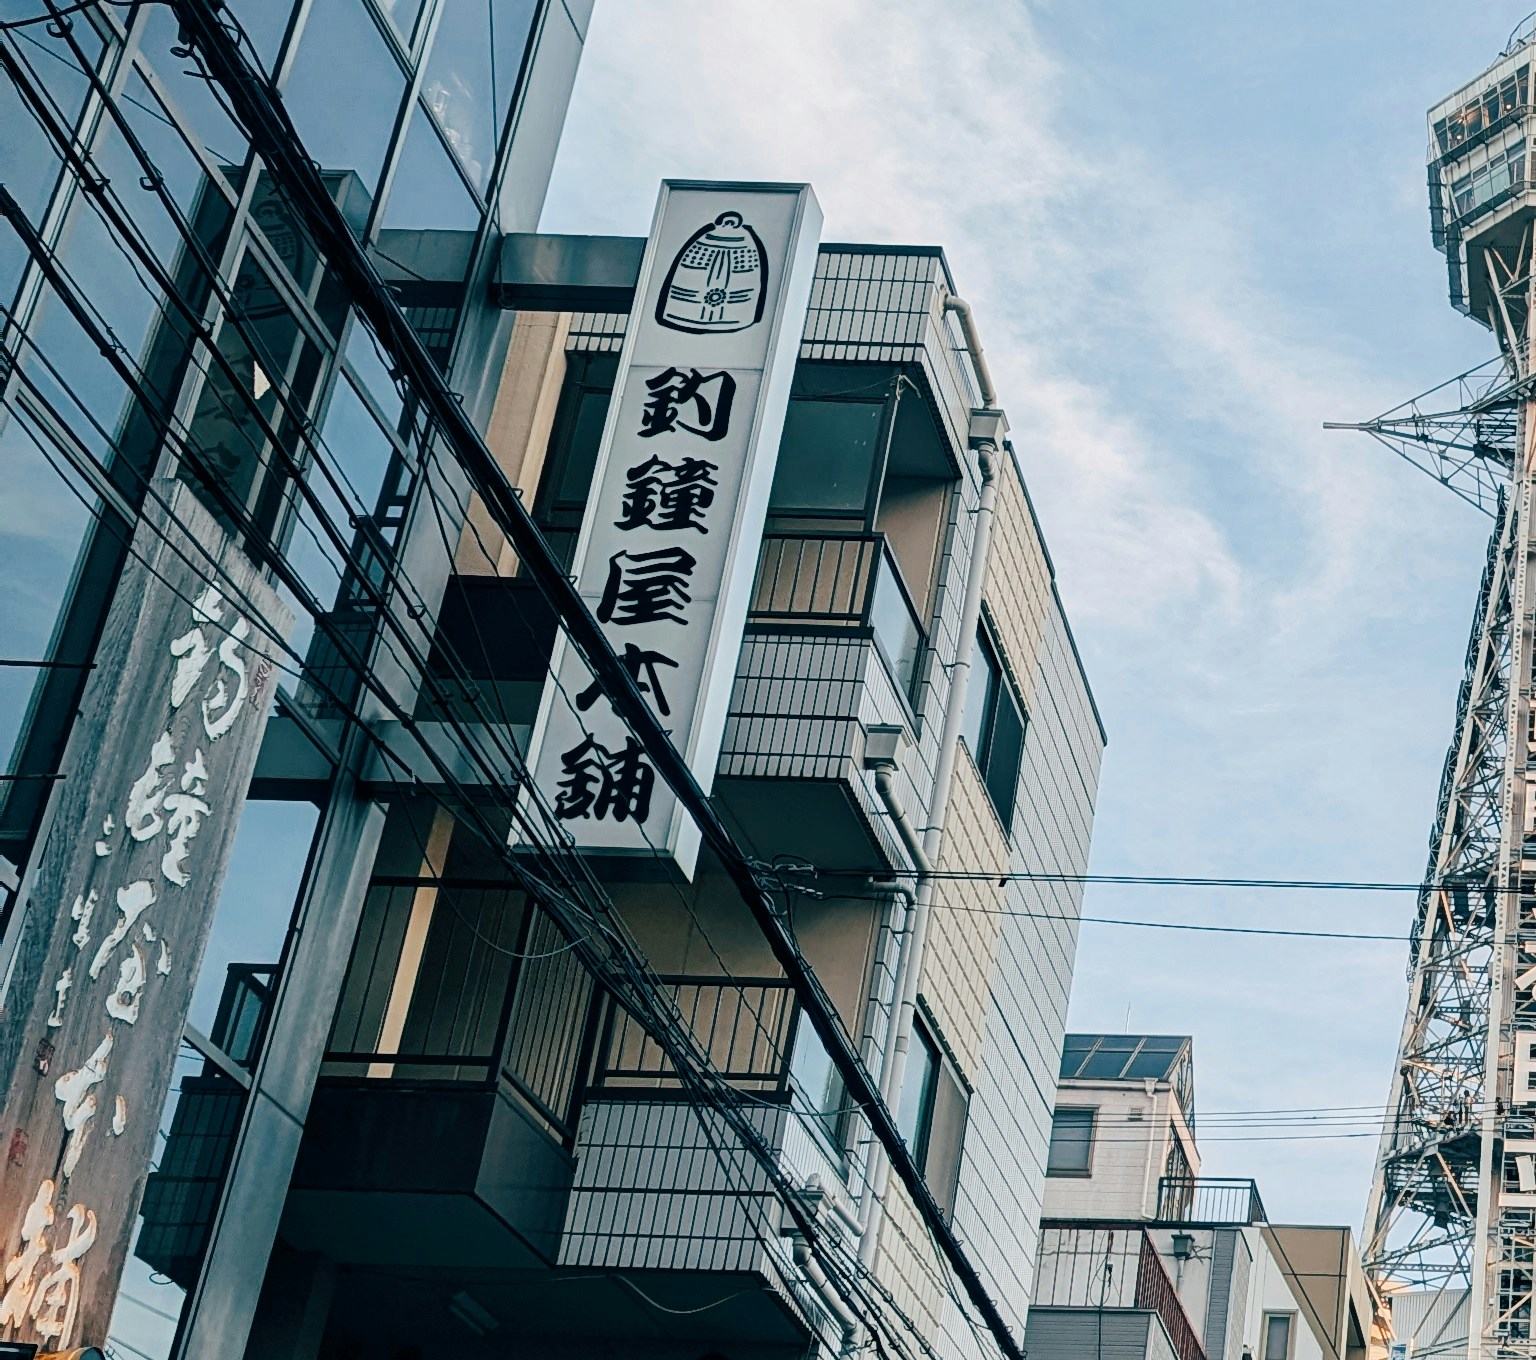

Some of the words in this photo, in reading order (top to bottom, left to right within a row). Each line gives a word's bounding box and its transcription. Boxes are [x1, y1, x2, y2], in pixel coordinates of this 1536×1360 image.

[553, 366, 735, 824] 釣鐘屋本舗
